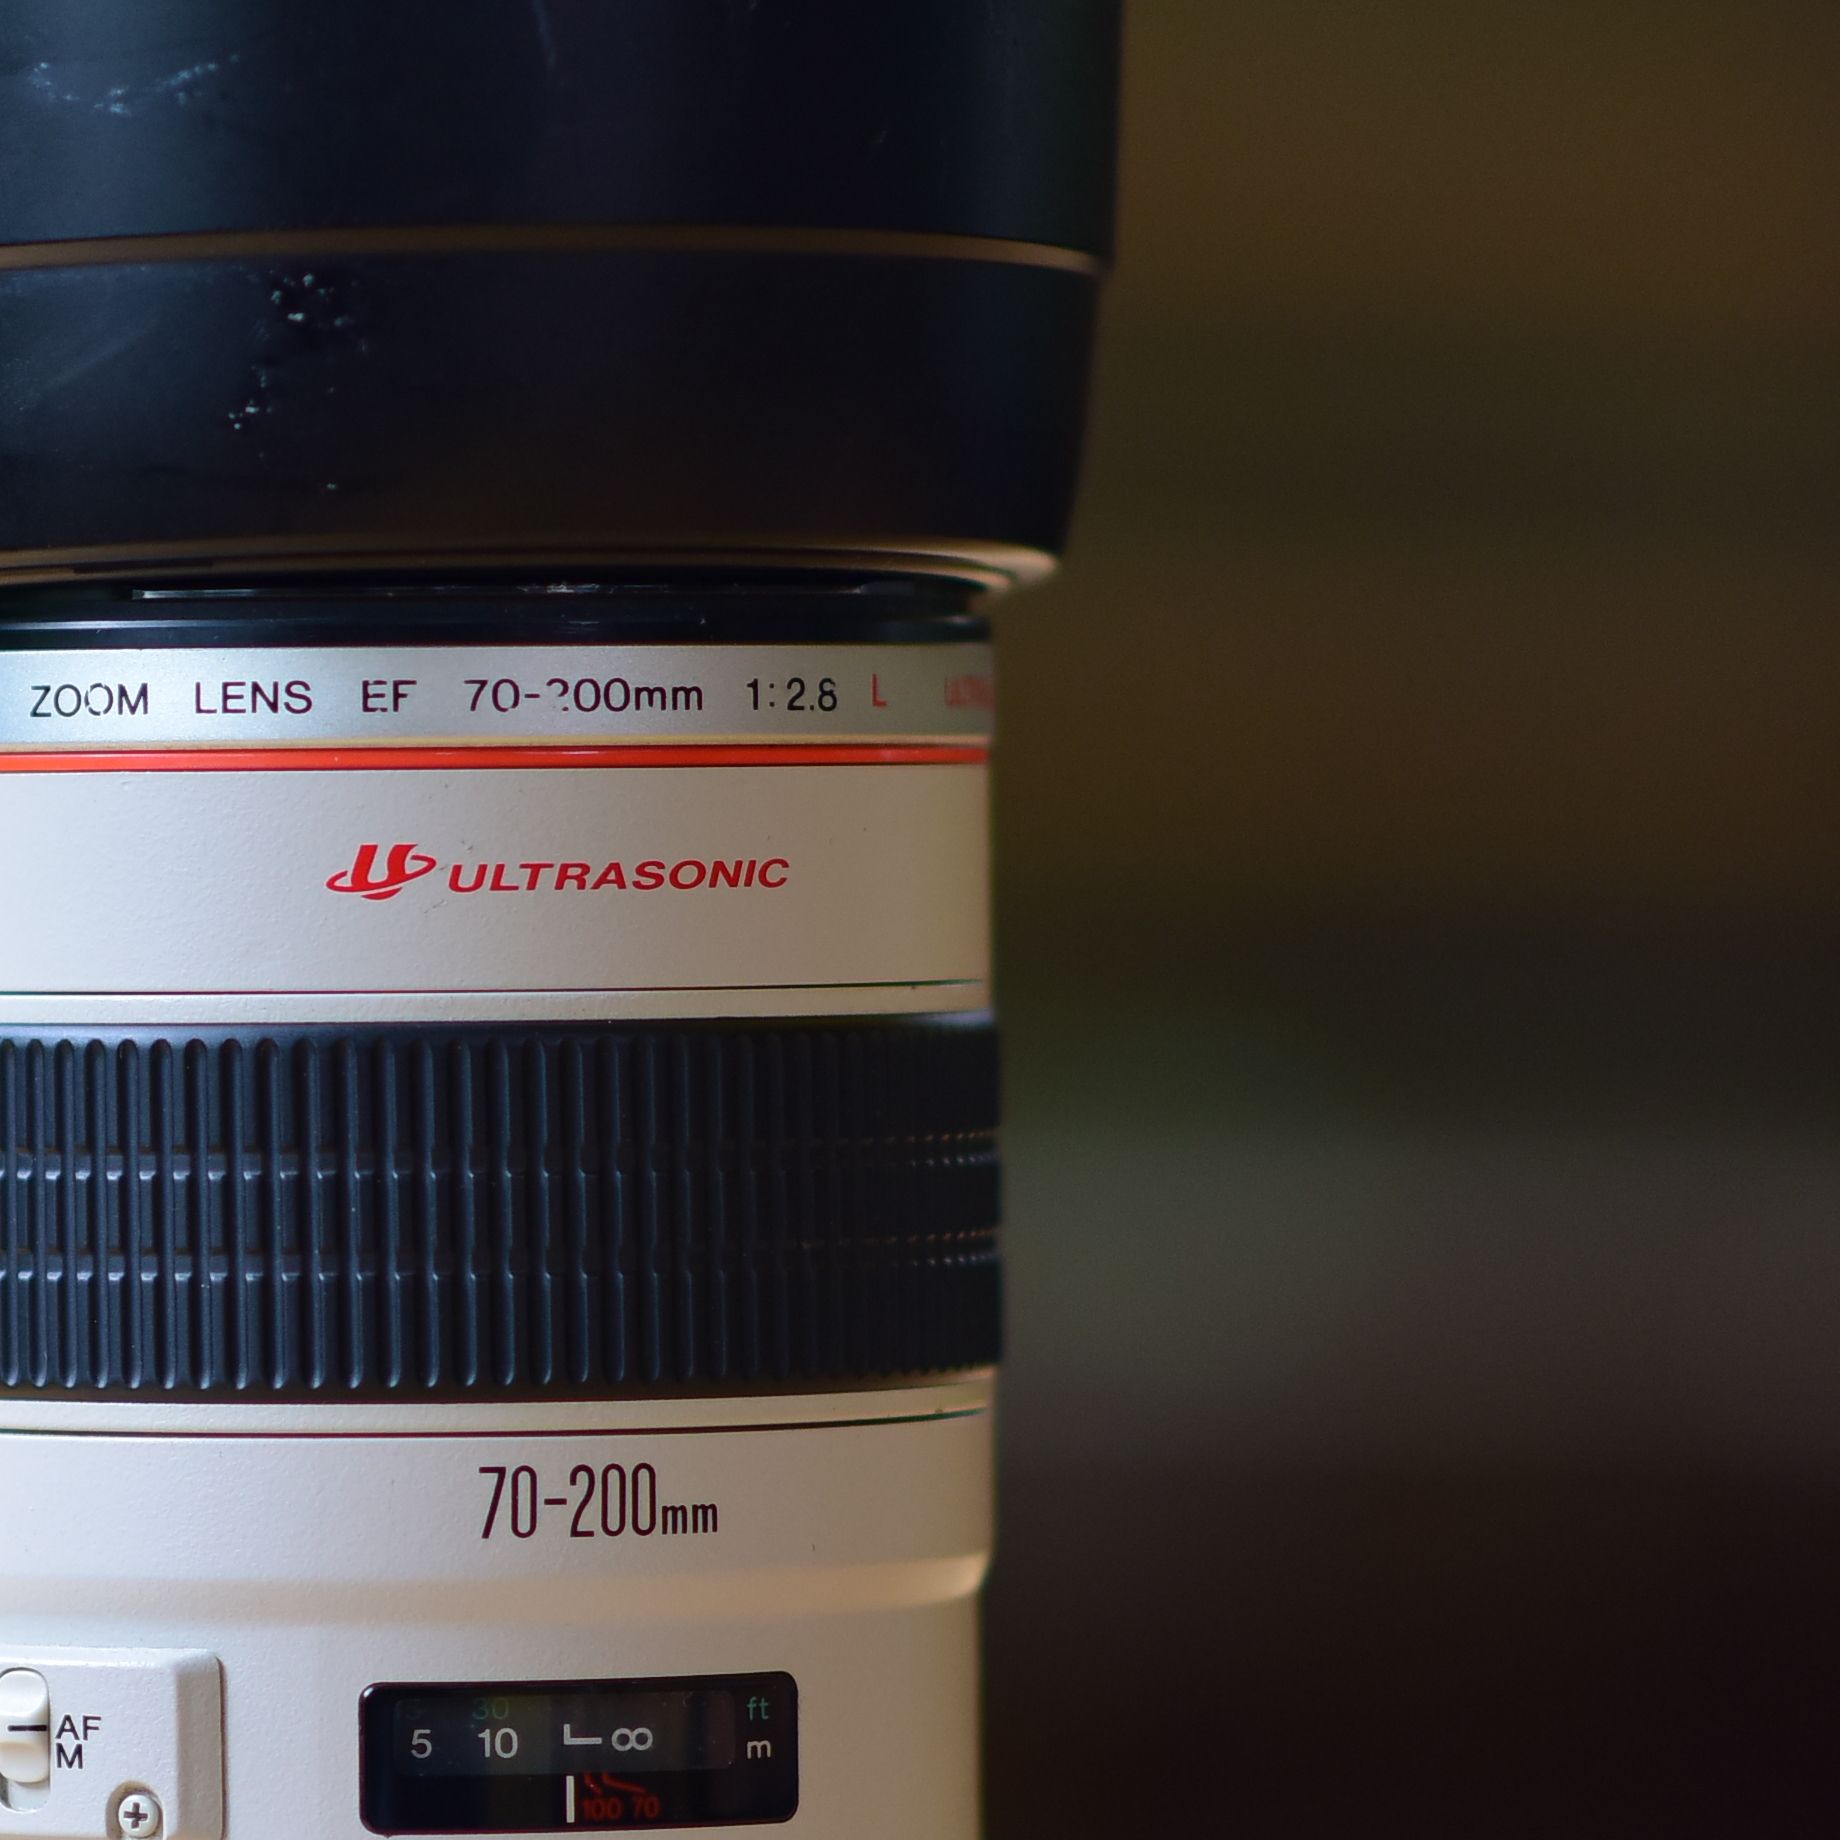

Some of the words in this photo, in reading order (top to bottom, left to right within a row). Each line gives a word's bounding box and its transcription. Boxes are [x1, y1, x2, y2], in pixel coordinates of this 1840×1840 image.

[30, 682, 149, 717] ZOOM
[194, 680, 313, 714] LENS
[362, 679, 418, 713] EF
[871, 673, 888, 709] L
[447, 858, 790, 893] ULTRASONIC
[479, 1462, 719, 1540] 70-200mm
[472, 1697, 510, 1721] 30
[746, 1697, 770, 1721] ft
[55, 1714, 103, 1742] AF
[56, 1743, 84, 1770] M
[410, 1728, 433, 1760] 5
[477, 1727, 519, 1759] 10
[746, 1737, 772, 1760] m
[582, 1797, 622, 1821] 100
[633, 1795, 661, 1820] 70
